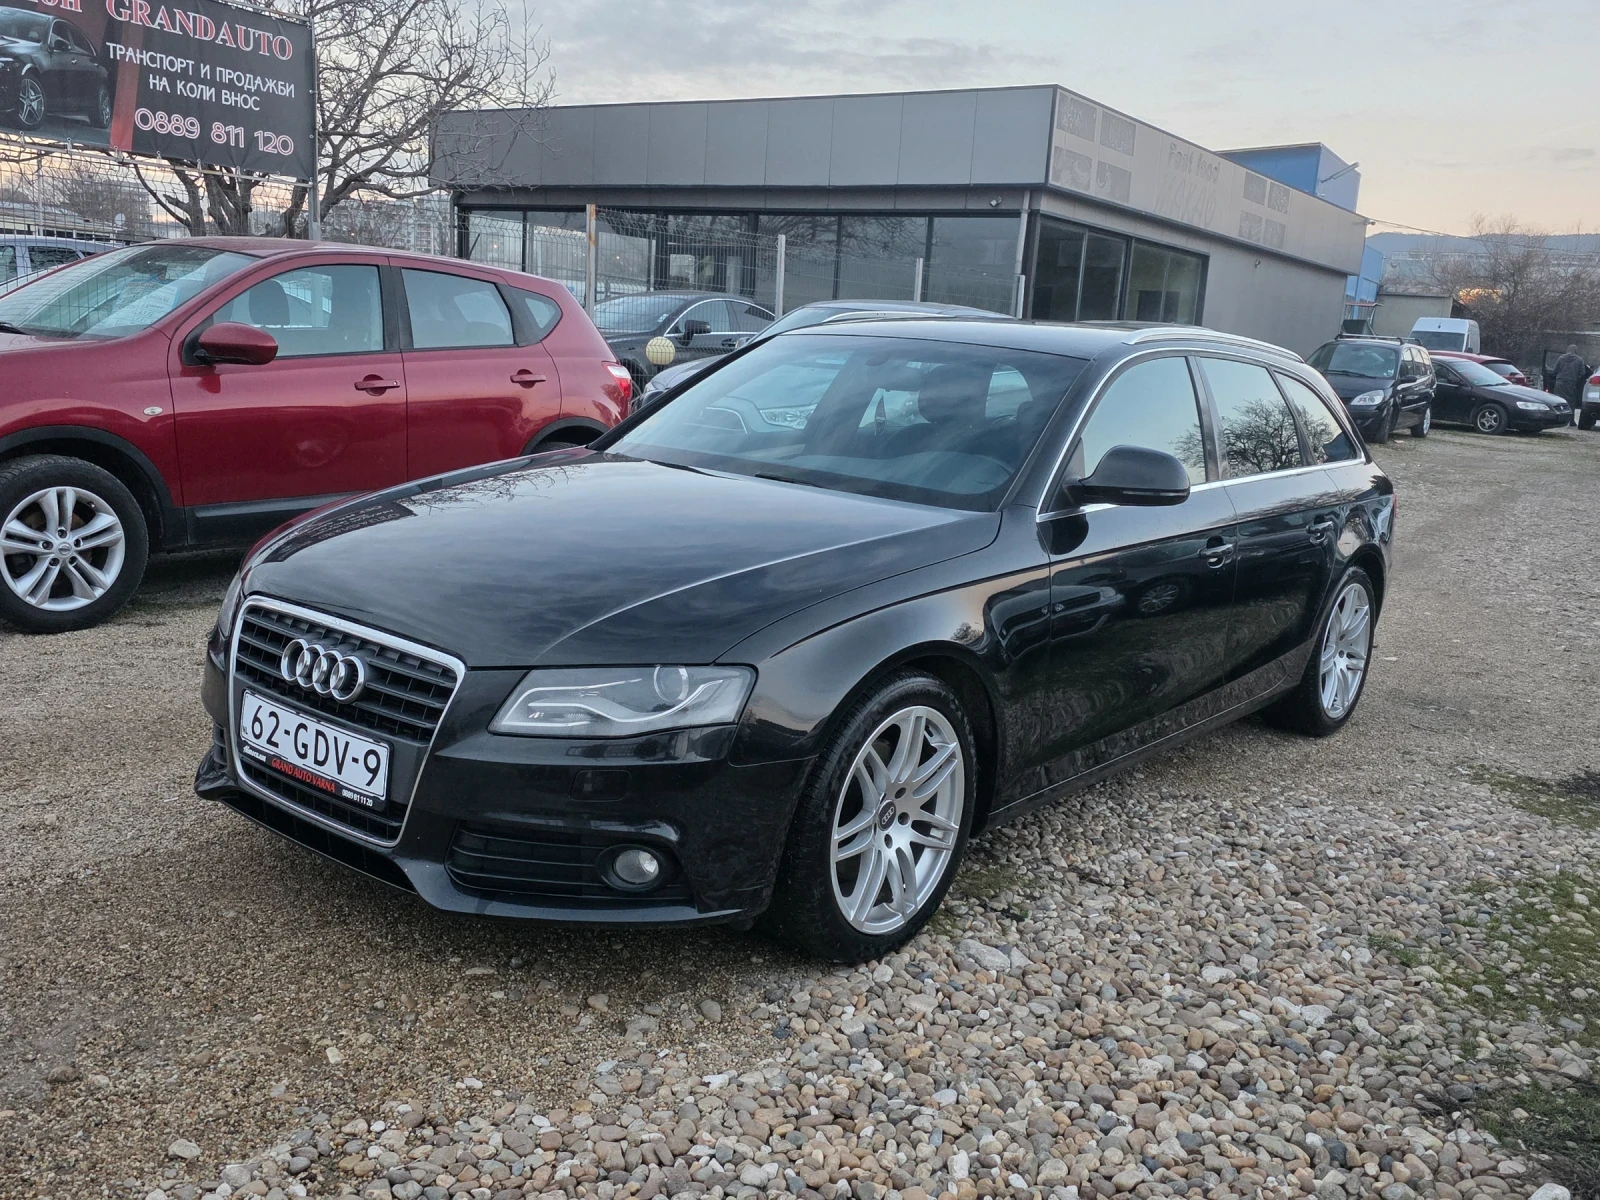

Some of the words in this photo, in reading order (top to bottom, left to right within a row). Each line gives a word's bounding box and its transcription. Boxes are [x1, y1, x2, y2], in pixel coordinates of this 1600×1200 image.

[105, 0, 293, 61] GRANDAUTO
[105, 42, 195, 76] ТРАНСПОРТ
[200, 63, 211, 80] И
[216, 66, 295, 98] ПРОДАЖБИ
[149, 74, 171, 93] НА
[177, 80, 216, 102] КОЛИ
[221, 89, 260, 111] ВНОС
[134, 107, 201, 139] 0889
[211, 121, 245, 148] 811
[254, 130, 294, 156] 120
[251, 704, 381, 787] 62-GDV-9
[271, 758, 293, 775] GRAND
[293, 767, 311, 783] AUTO
[311, 777, 336, 793] VARNA
